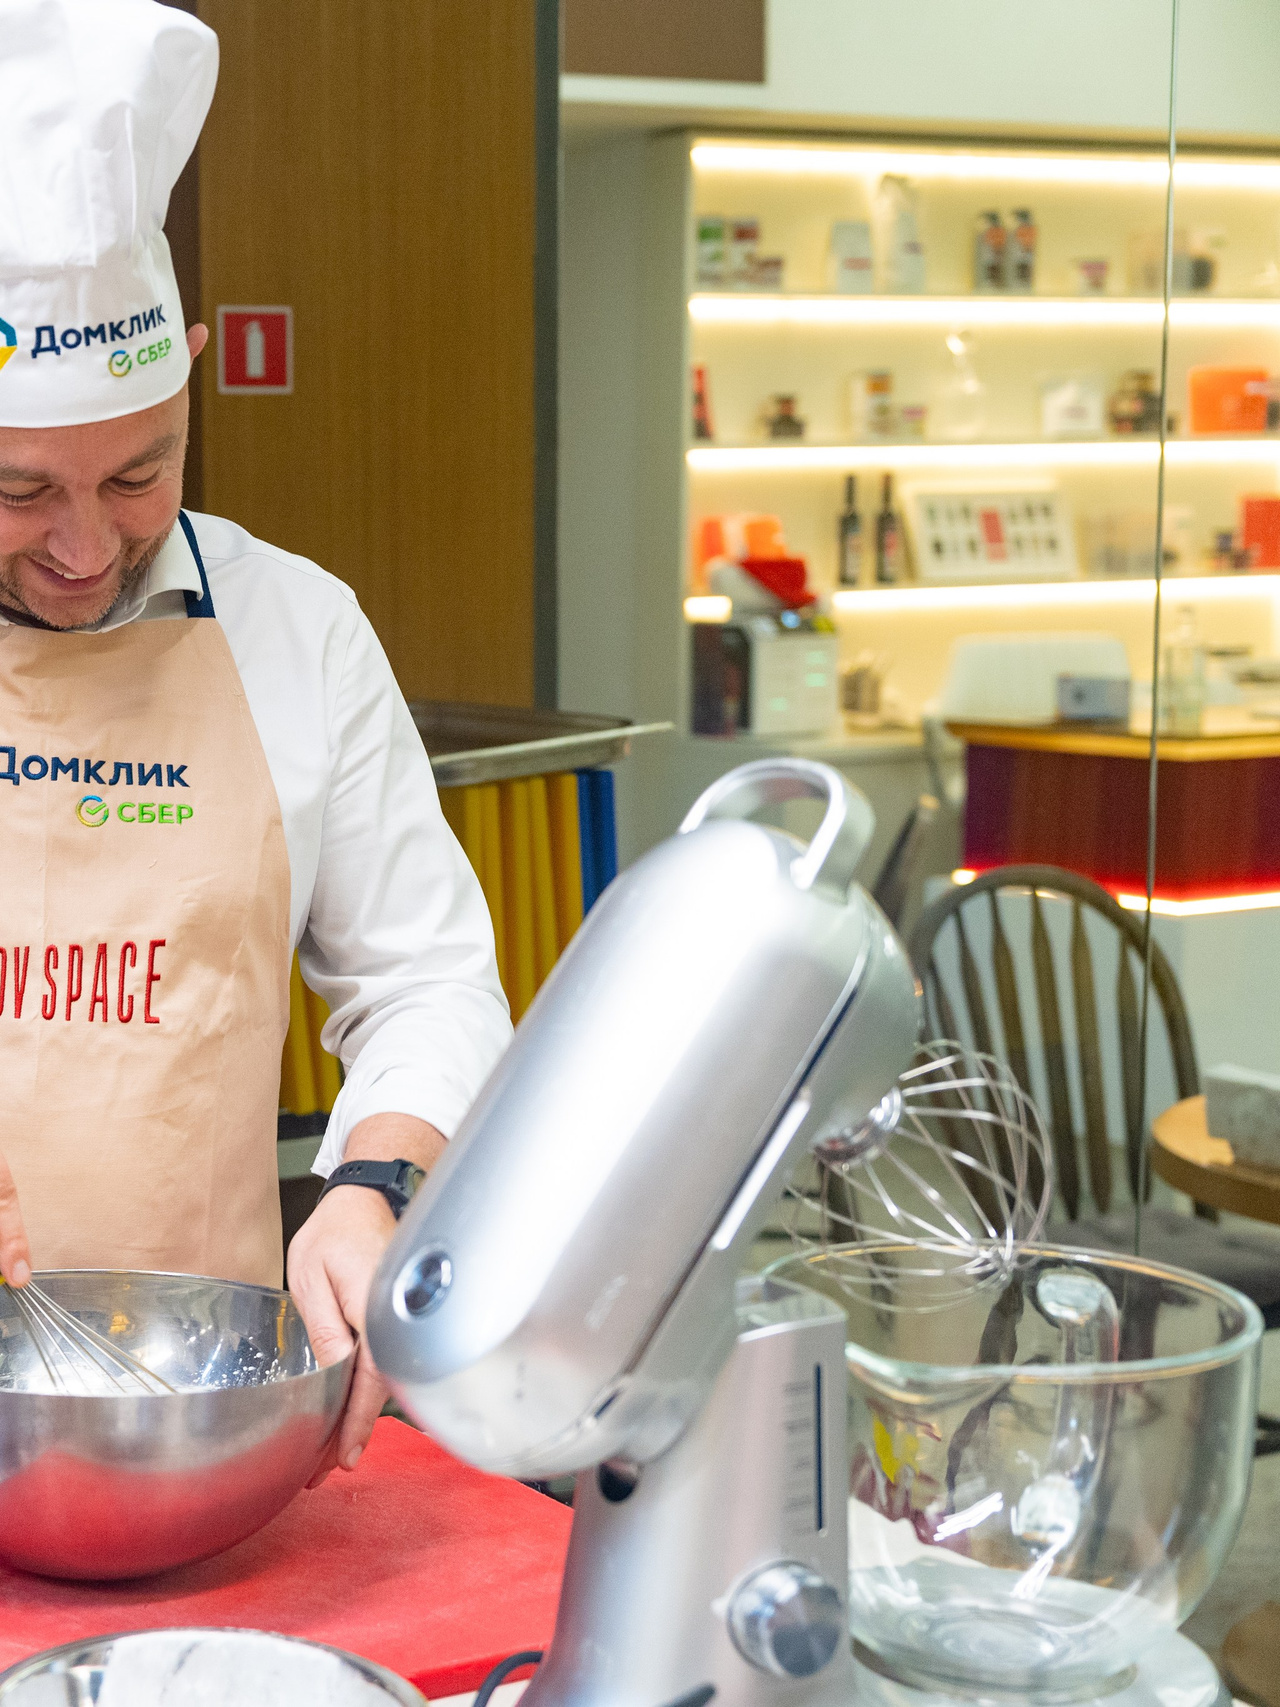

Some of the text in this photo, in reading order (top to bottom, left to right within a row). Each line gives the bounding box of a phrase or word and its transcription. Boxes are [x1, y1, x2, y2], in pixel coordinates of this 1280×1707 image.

[136, 337, 172, 366] СБЕР
[117, 802, 194, 824] СБЕР
[41, 938, 166, 1024] SPACE
